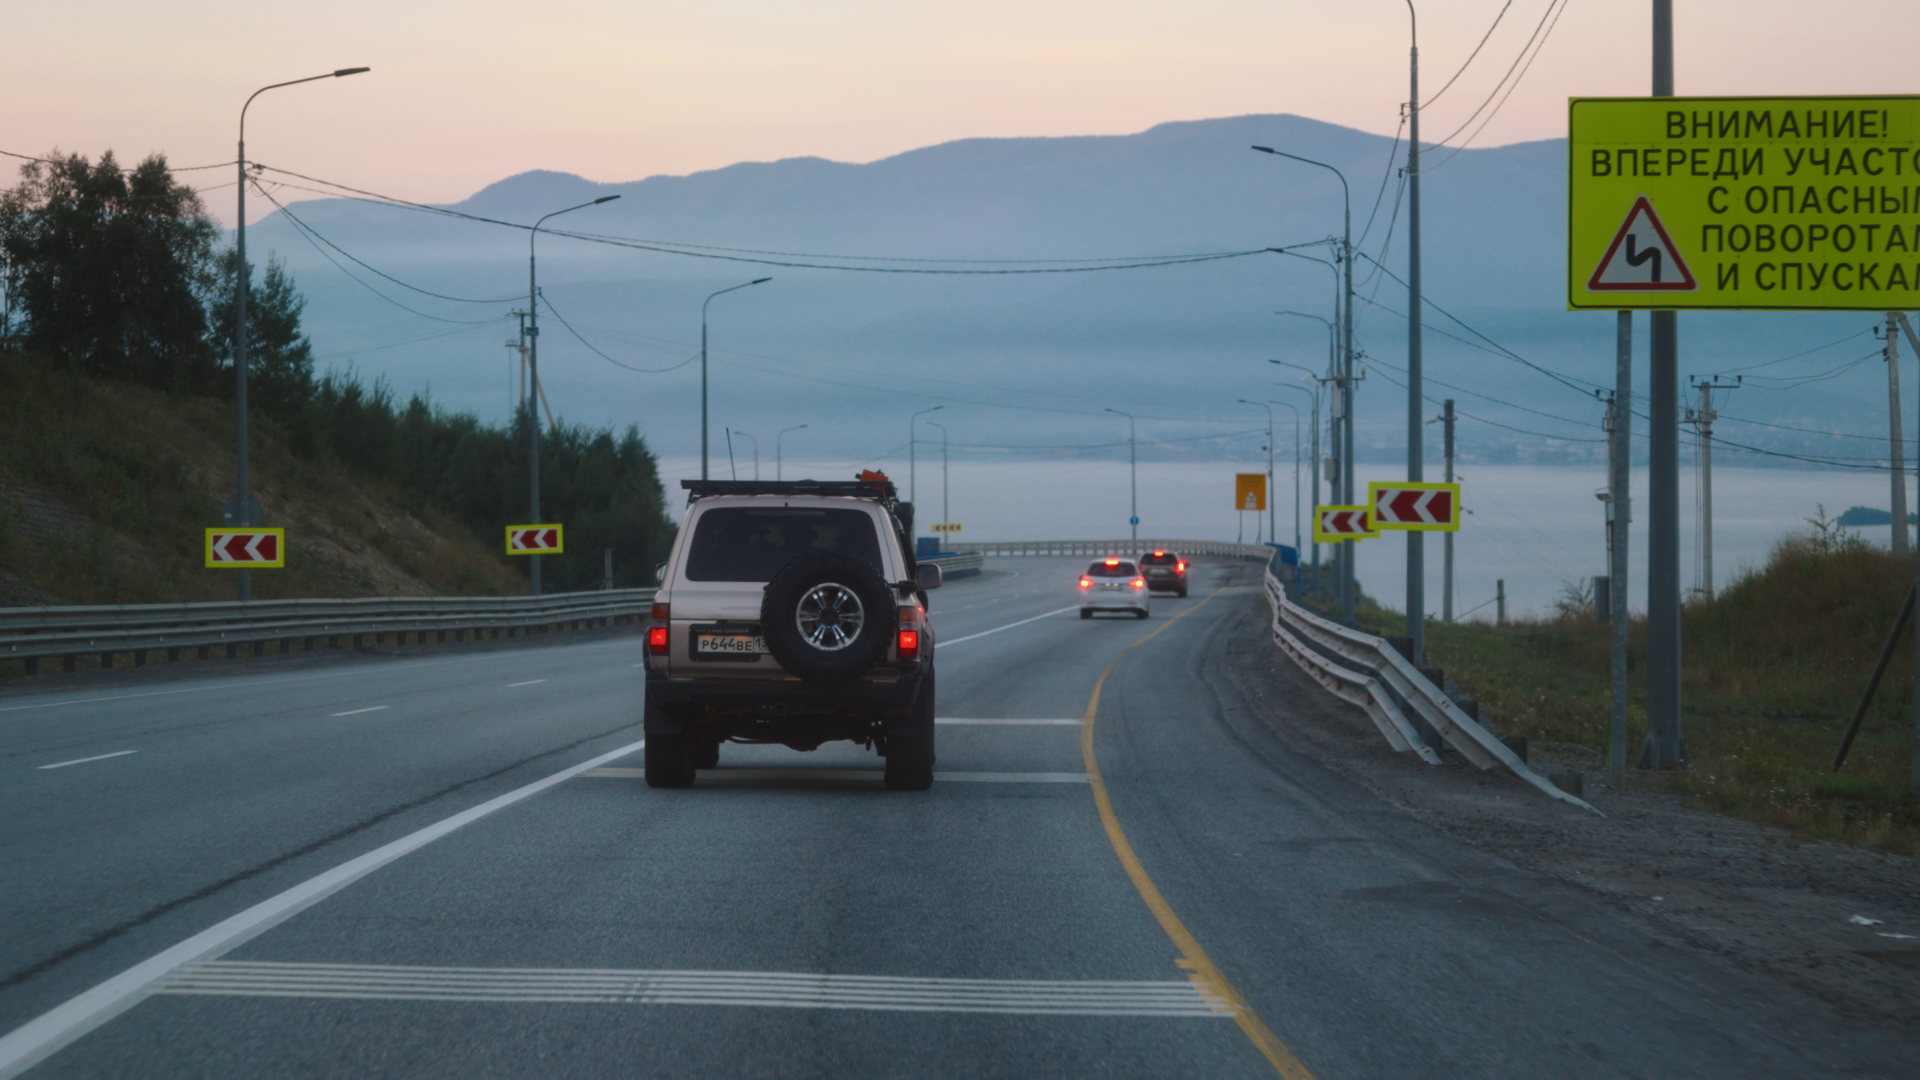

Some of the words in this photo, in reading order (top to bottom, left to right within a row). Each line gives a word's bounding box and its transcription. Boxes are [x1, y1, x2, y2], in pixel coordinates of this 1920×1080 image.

[1666, 109, 1888, 139] ВНИМАНИЕ!
[1592, 148, 1764, 181] ВПЕРЕДИ
[1707, 185, 1729, 214] С
[1744, 185, 1920, 214] ОПАСНЫ
[1702, 224, 1920, 253] ПОВОРОТА
[1717, 263, 1739, 291] И
[1755, 262, 1920, 291] СПУСКА
[755, 638, 767, 648] 13
